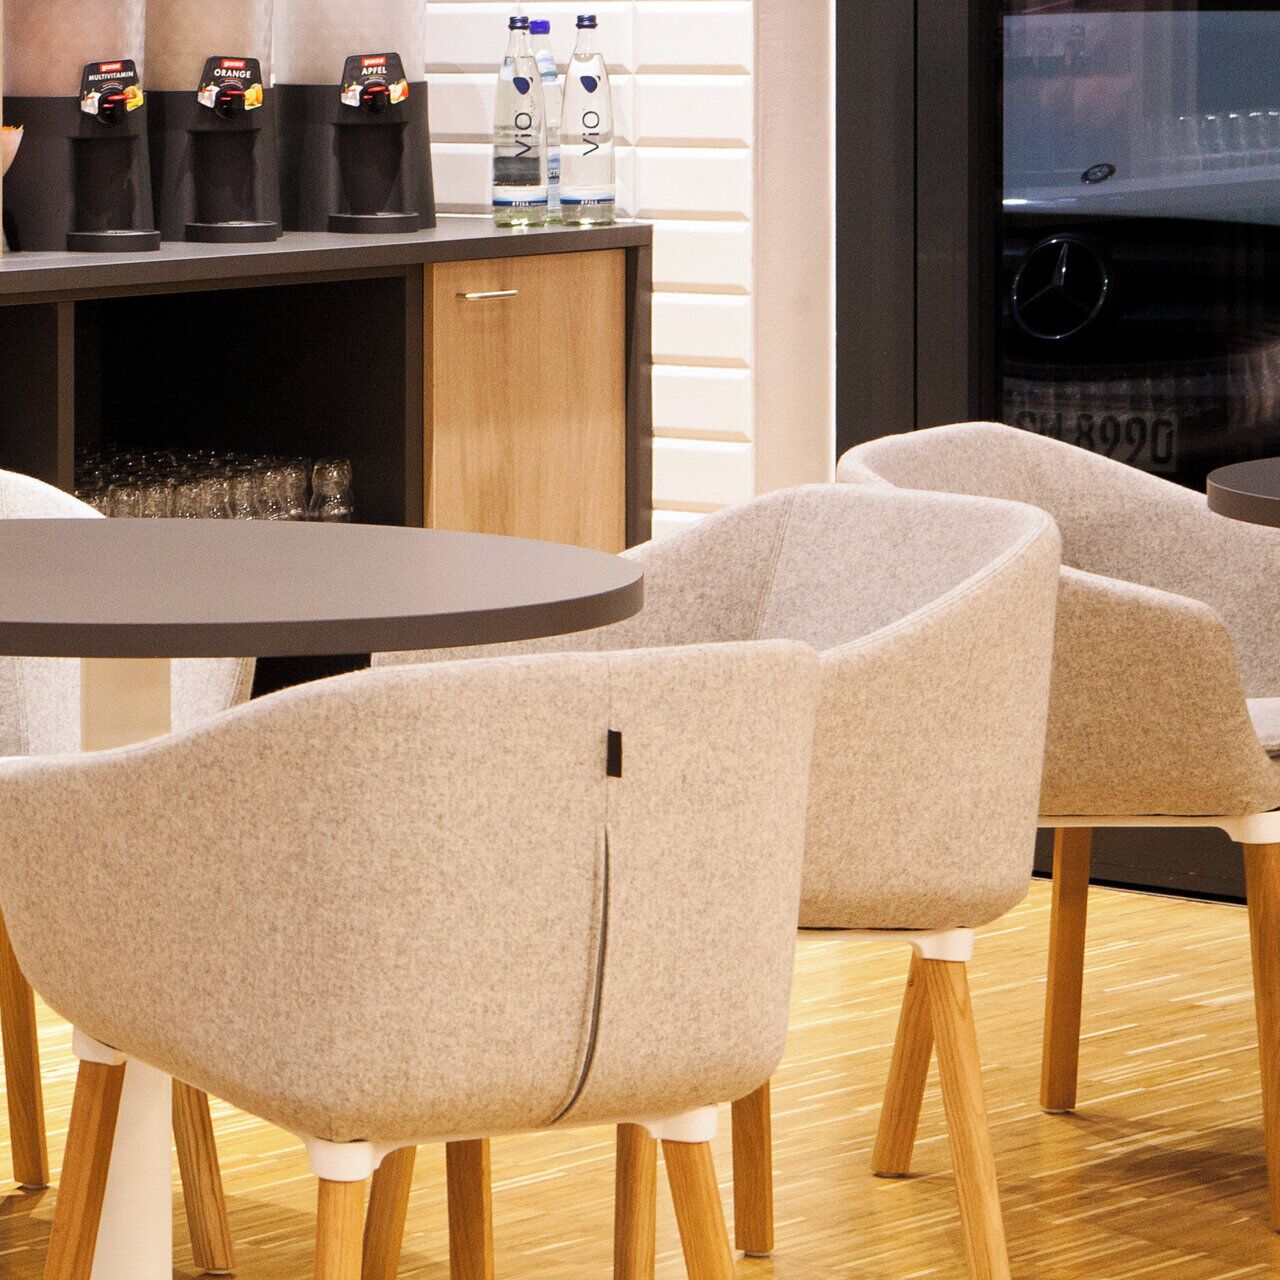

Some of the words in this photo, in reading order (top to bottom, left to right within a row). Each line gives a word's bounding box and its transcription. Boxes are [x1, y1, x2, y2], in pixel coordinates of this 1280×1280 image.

[213, 68, 251, 78] ORANGE
[361, 66, 387, 75] APFEL
[88, 71, 134, 81] MULTIVITAMIN
